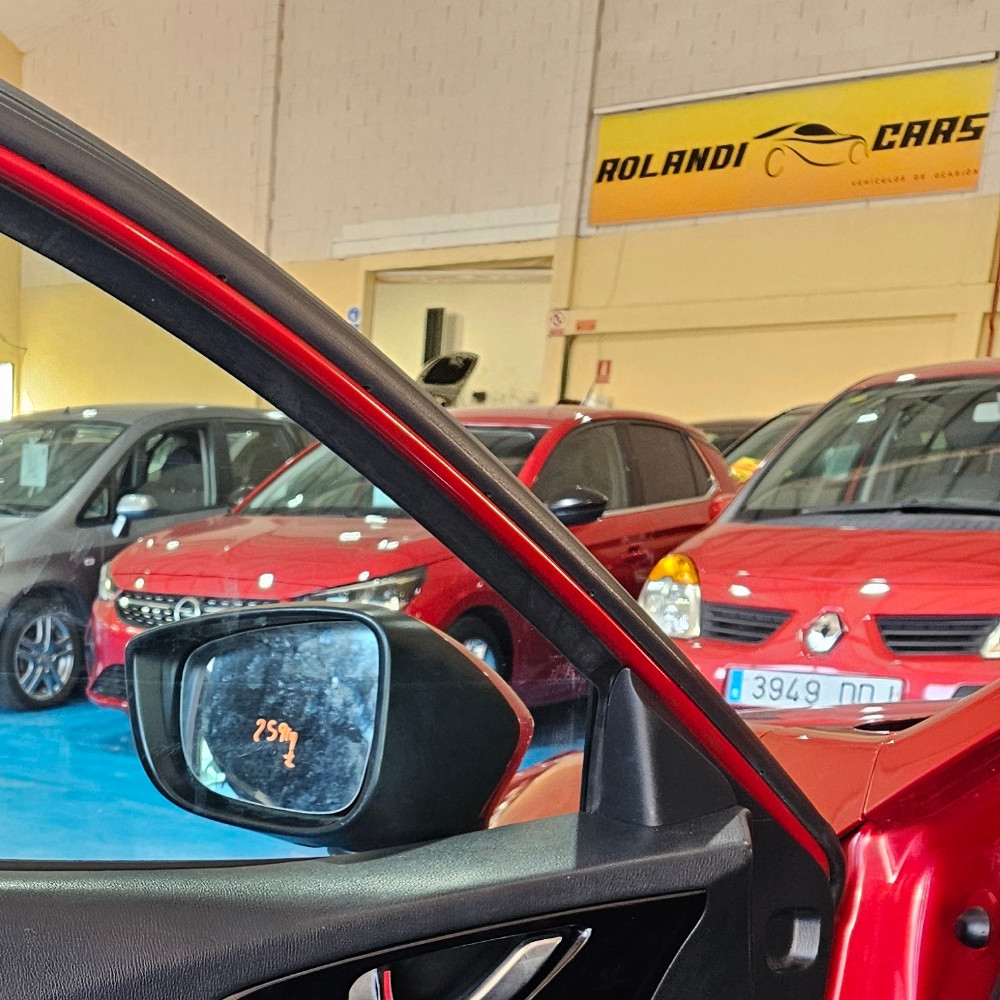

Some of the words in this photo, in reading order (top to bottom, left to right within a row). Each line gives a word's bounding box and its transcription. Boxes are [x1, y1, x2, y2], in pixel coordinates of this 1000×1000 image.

[596, 142, 749, 184] ROLANDI
[871, 112, 990, 152] CARS
[752, 676, 821, 704] 3949
